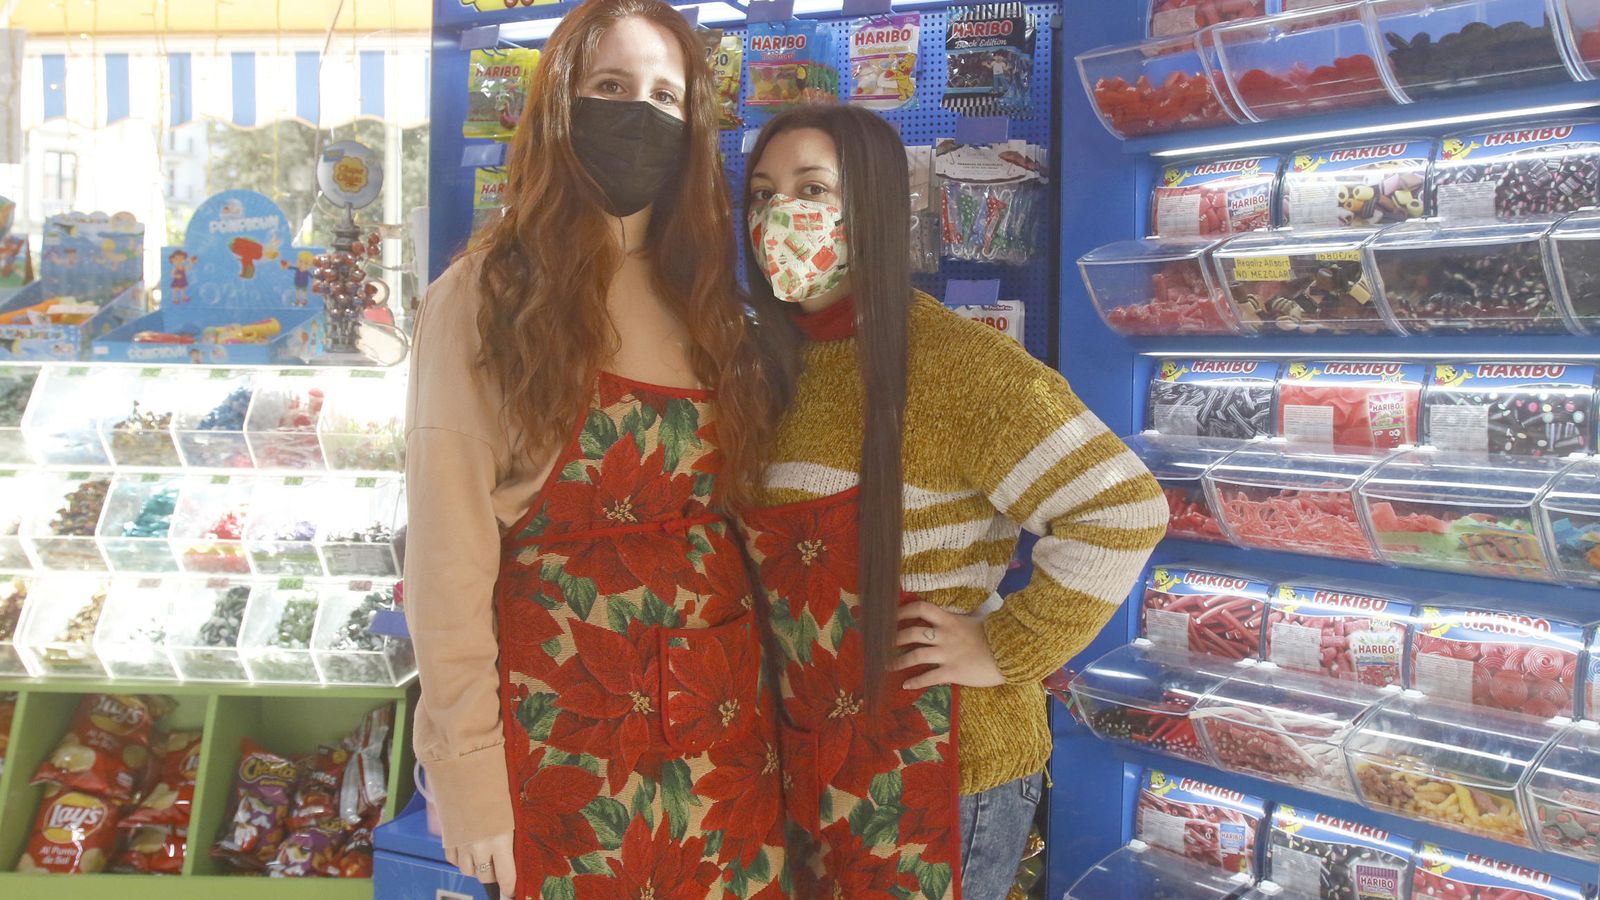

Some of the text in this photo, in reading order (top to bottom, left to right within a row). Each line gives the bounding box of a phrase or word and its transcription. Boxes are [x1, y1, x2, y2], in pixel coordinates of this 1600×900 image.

[953, 20, 1013, 37] HARIBO
[751, 35, 806, 50] HARIBO
[854, 28, 911, 46] HARIBO
[979, 38, 1007, 48] Edition
[475, 65, 521, 77] HARIBO
[1484, 126, 1574, 147] HARIBO
[1330, 144, 1407, 162] HARIBO
[1194, 159, 1259, 176] HARIBO
[1231, 194, 1265, 210] HARIBO
[1236, 269, 1289, 278] NO MEZCLAR
[1192, 360, 1258, 374] HARIBO
[1324, 363, 1401, 376] HARIBO
[1477, 364, 1566, 379] HARIBO
[1372, 402, 1400, 411] HARIBO
[1184, 570, 1249, 590] HARIBO
[1314, 591, 1388, 612] HARIBO
[1462, 611, 1551, 639] HARIBO
[1358, 645, 1395, 654] HARIBO
[1180, 777, 1244, 802] HARIBO
[48, 804, 104, 831] Lay's
[1360, 877, 1394, 888] HARIBO
